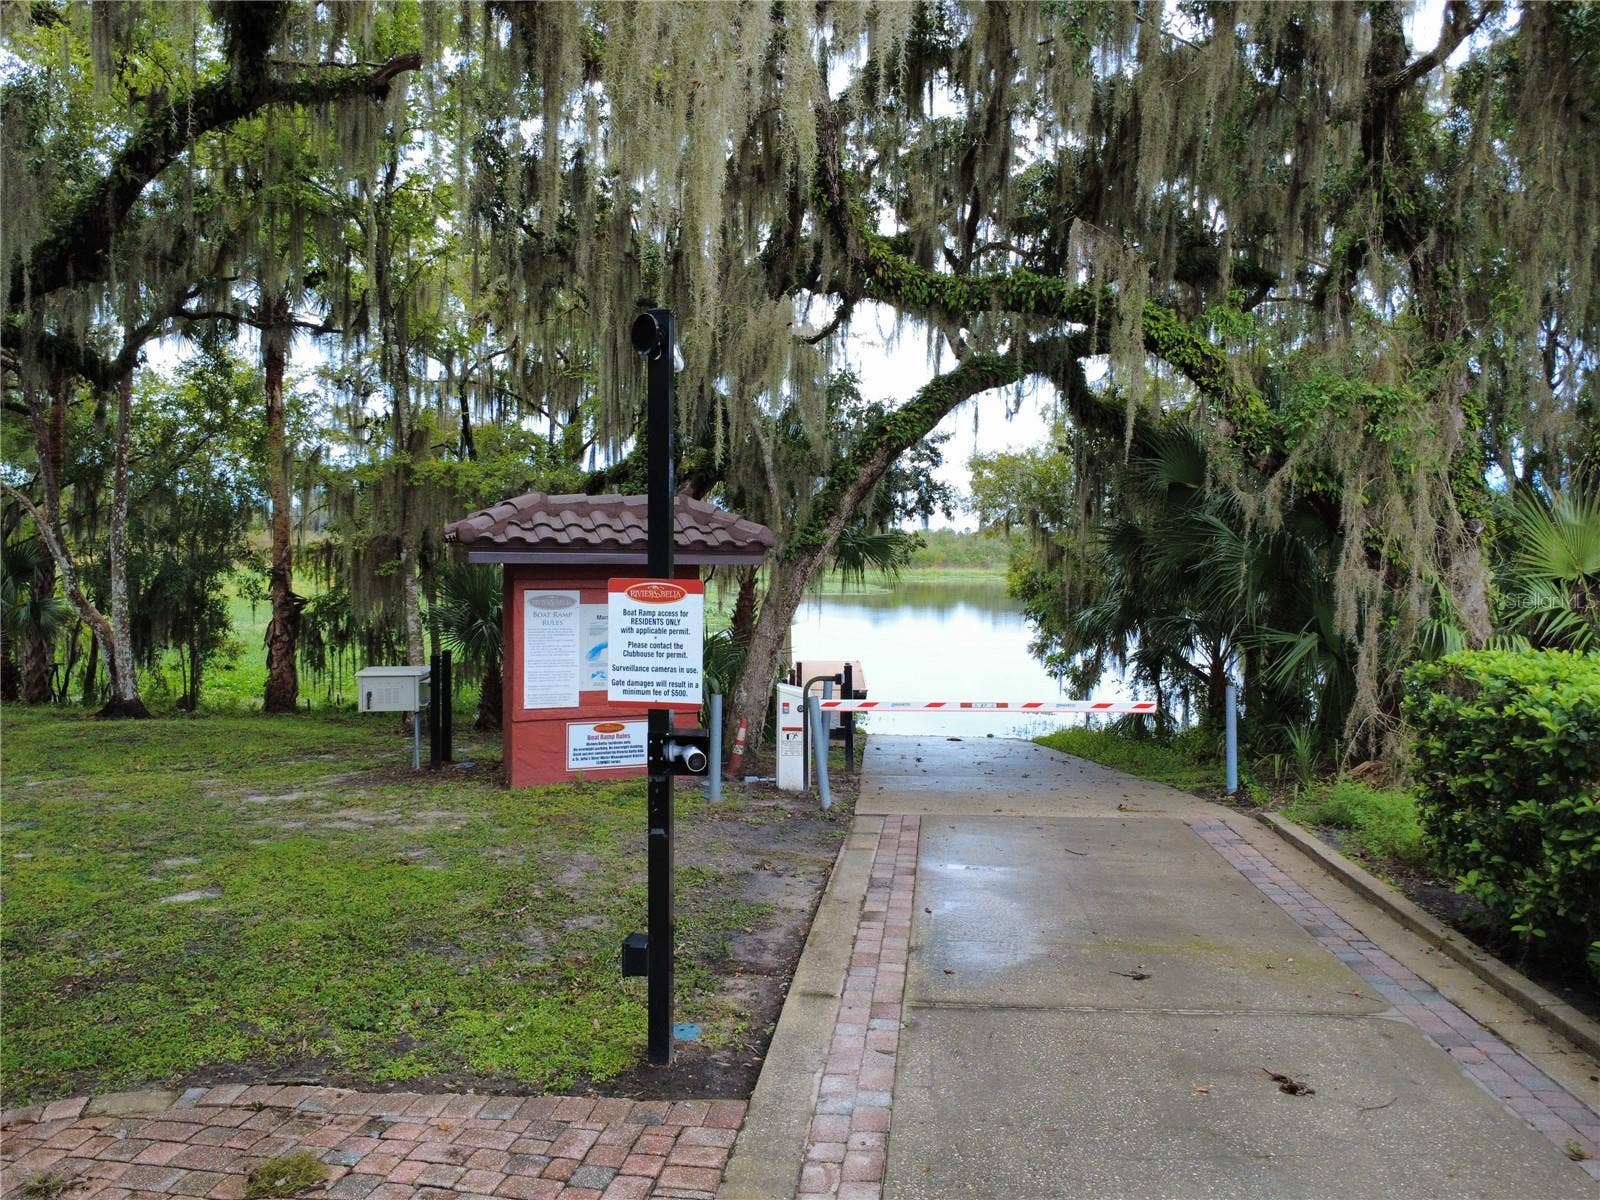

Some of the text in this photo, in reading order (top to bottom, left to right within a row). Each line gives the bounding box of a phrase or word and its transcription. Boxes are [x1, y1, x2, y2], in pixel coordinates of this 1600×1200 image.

[638, 609, 656, 617] Ramp
[630, 618, 681, 626] RESIDENTS ONLY
[635, 627, 668, 635] applicable
[668, 628, 690, 636] permit.
[627, 641, 648, 649] Please
[673, 642, 684, 650] the
[666, 651, 688, 659] permit.
[611, 664, 650, 672] Surveillance
[626, 680, 654, 688] damages
